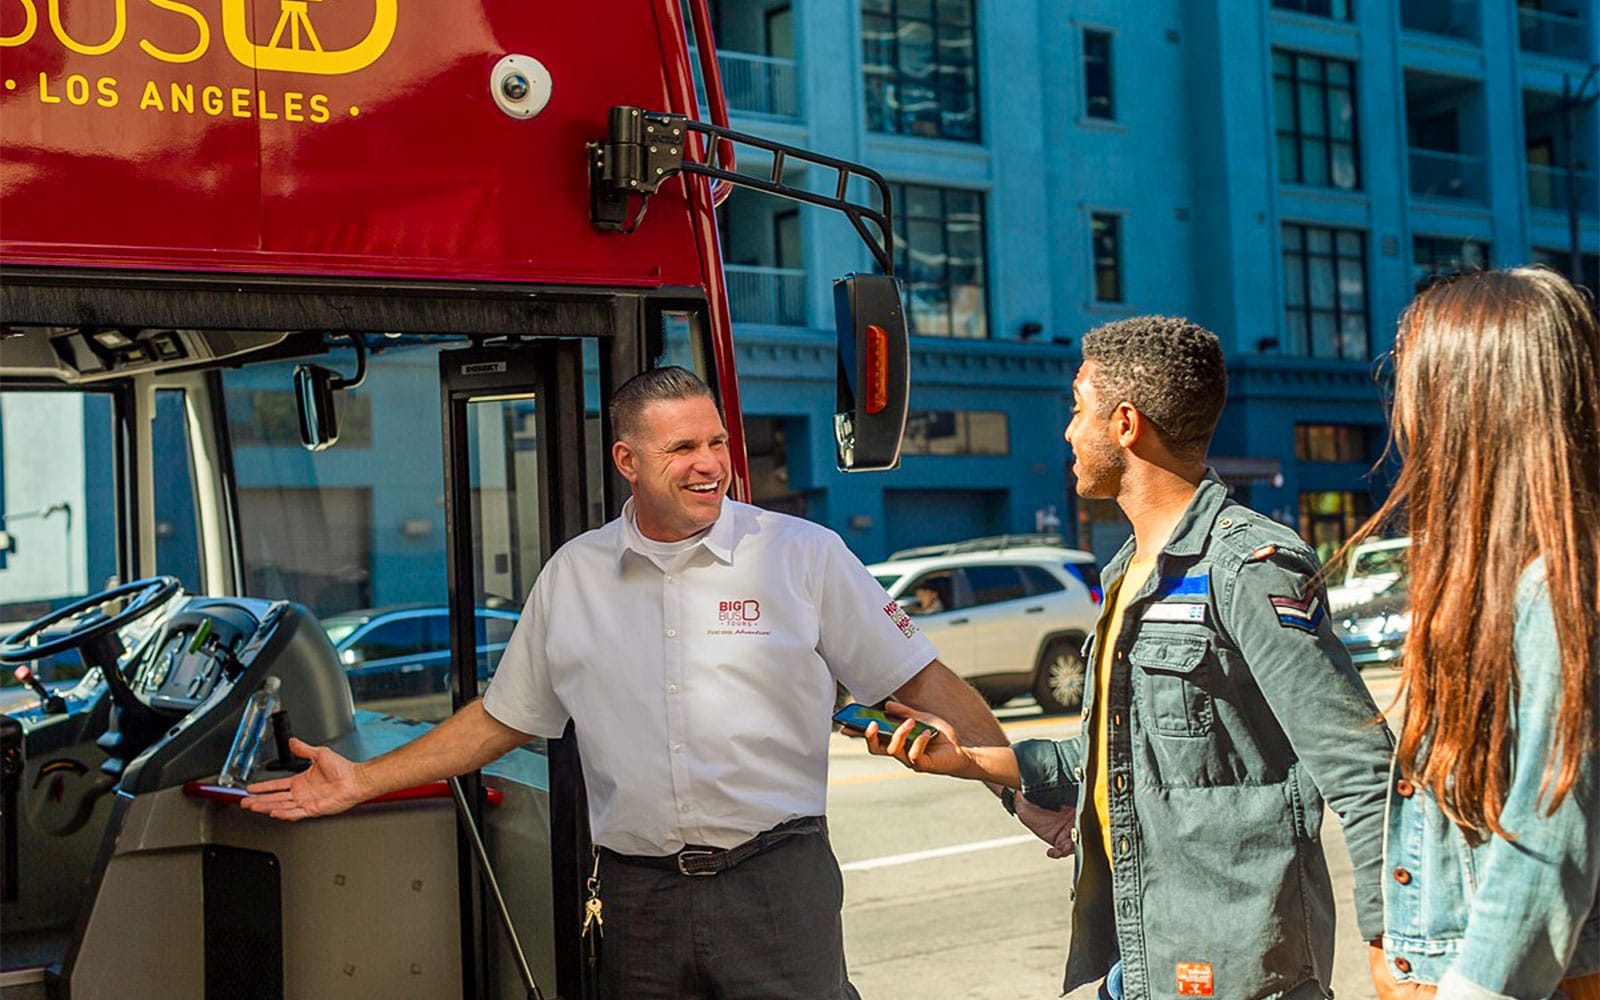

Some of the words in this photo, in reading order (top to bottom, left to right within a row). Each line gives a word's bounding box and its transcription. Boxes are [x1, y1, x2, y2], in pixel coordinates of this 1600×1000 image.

[0, 0, 211, 63] US
[38, 72, 119, 108] LOS
[139, 80, 330, 123] ANGELES
[719, 601, 742, 611] BIG
[719, 611, 742, 621] BUS
